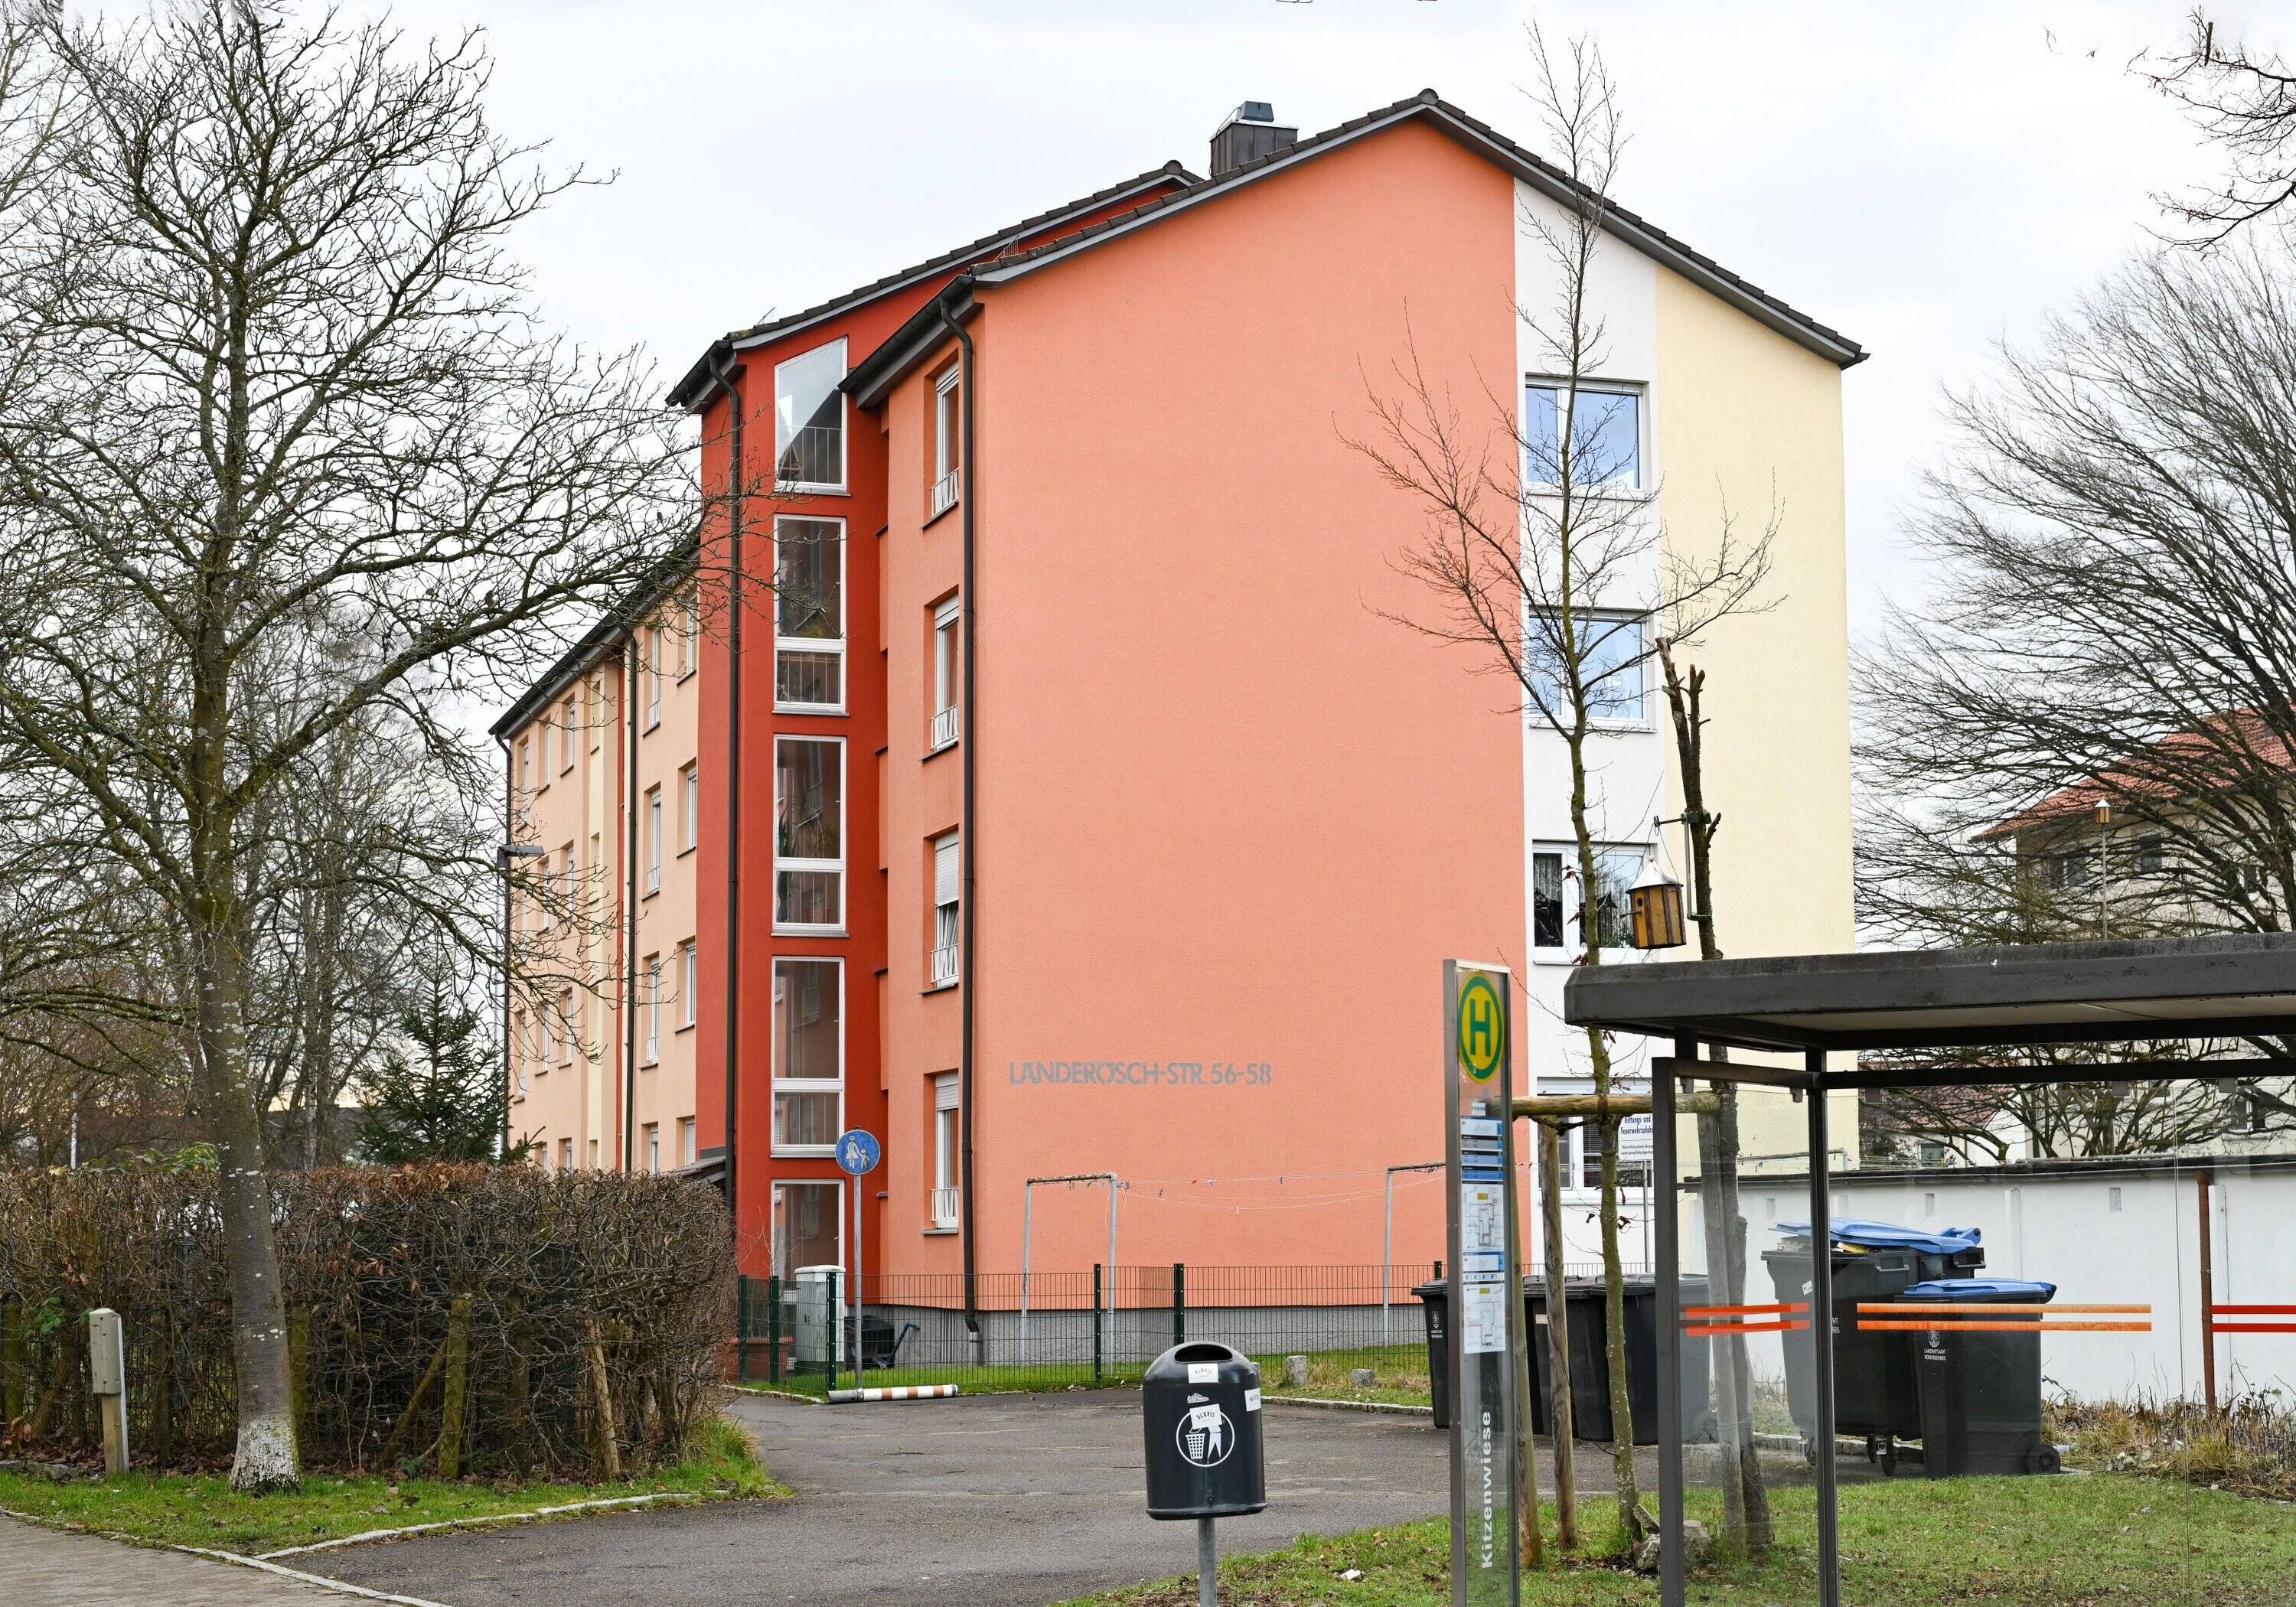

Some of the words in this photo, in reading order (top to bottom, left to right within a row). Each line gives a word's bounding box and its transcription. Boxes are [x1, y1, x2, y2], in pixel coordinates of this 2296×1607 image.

[1470, 998, 1491, 1057] H
[1211, 1061, 1272, 1085] 56-58
[1621, 1125, 1653, 1135] Feuerwehrzufah
[1481, 1412, 1492, 1568] Kitzenwiese
